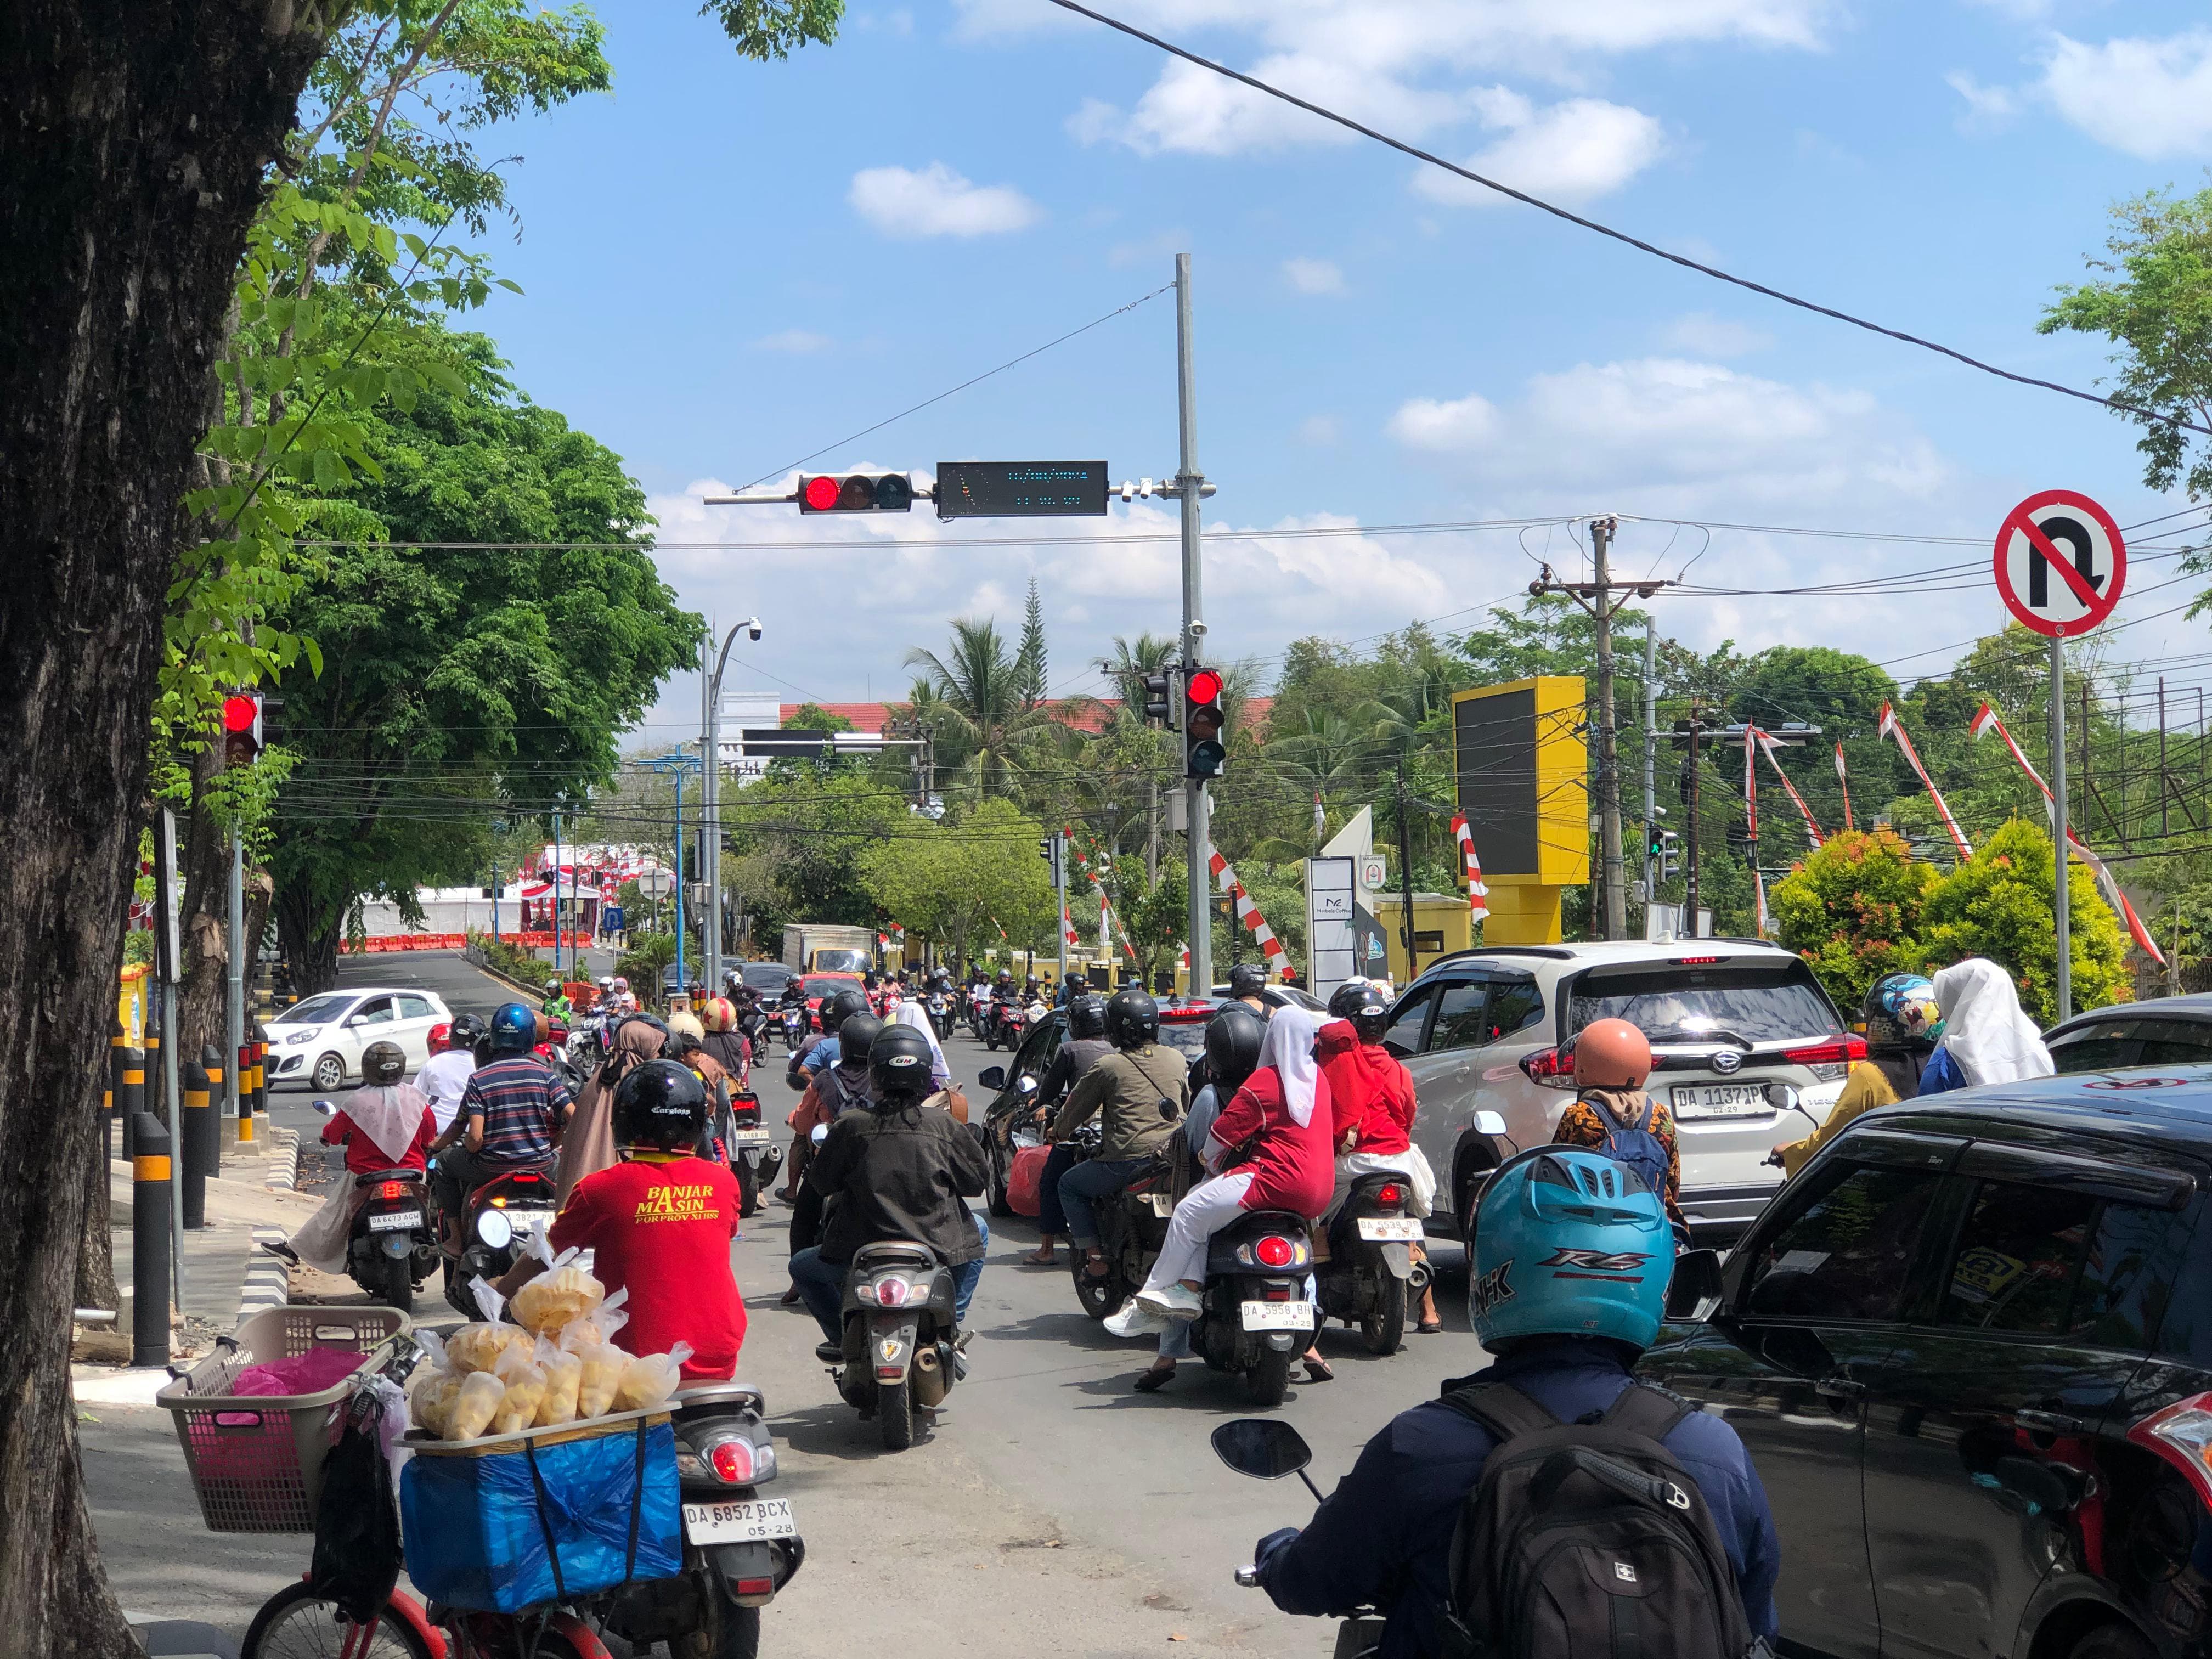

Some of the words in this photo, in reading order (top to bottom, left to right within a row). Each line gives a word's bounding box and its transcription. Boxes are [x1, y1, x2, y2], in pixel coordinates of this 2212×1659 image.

[1678, 1089, 1697, 1107] DA
[1704, 1087, 1742, 1105] 1137
[651, 1105, 691, 1115] Cargloss
[647, 1185, 714, 1202] BANJAR
[636, 1198, 704, 1215] MASIN
[383, 1215, 402, 1223] 6473
[1361, 1221, 1373, 1229] DA
[1244, 1305, 1257, 1316] DA
[1265, 1305, 1291, 1315] 5958
[1297, 1304, 1311, 1315] BH
[687, 1508, 708, 1524] DA
[713, 1504, 753, 1523] 6852
[758, 1500, 789, 1519] BCX
